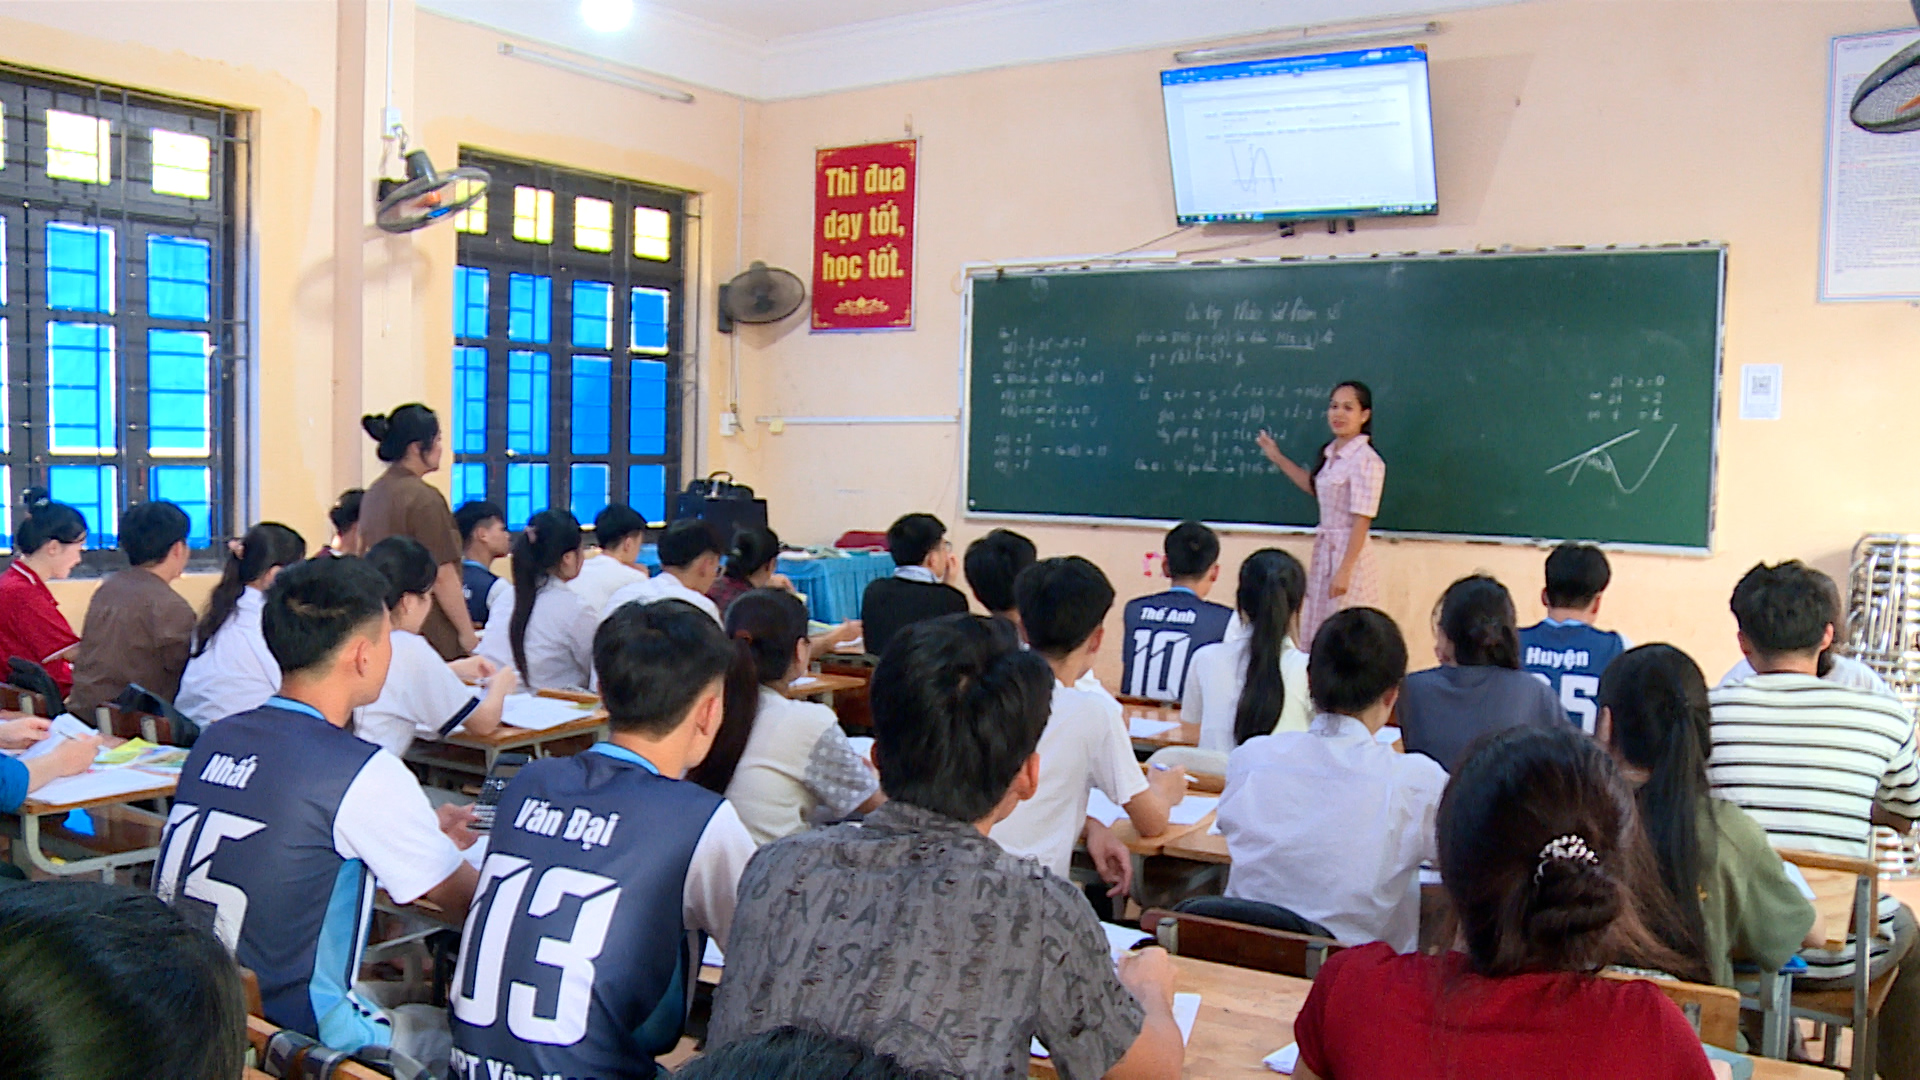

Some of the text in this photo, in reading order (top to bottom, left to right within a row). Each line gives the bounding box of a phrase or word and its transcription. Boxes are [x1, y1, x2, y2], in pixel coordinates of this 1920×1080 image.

[825, 163, 906, 197] Thi đua
[823, 199, 905, 245] dạy tốt,
[822, 243, 904, 287] học tốt.
[1141, 607, 1197, 624] Thế Anh
[1130, 629, 1191, 700] 10
[1525, 646, 1590, 671] Huyện
[200, 753, 259, 789] Nhất
[513, 797, 621, 850] Văn Đại
[450, 853, 622, 1046] 03
